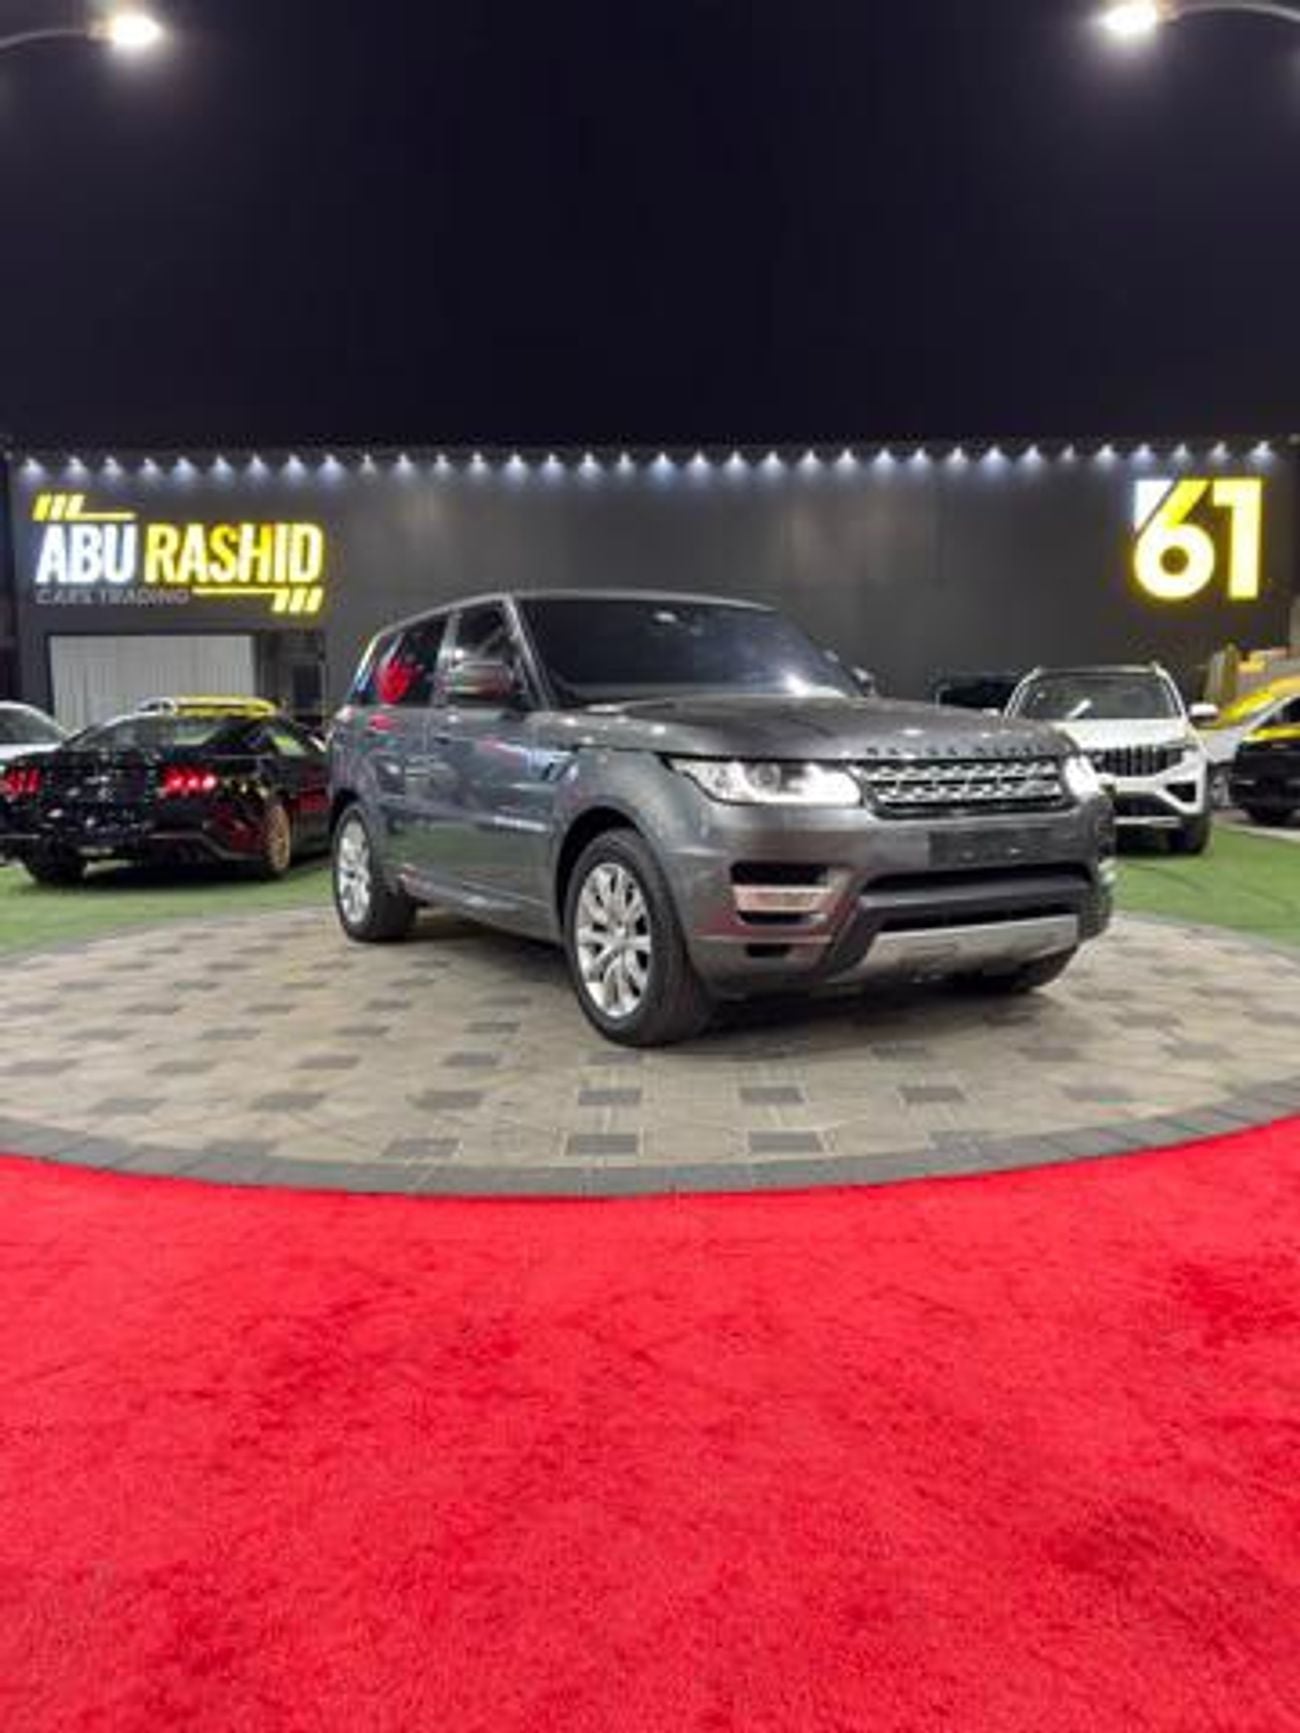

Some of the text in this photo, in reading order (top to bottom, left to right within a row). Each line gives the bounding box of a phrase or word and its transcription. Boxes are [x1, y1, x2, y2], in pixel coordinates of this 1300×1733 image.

[35, 522, 324, 584] ABU RASHID
[1133, 477, 1262, 600] 61
